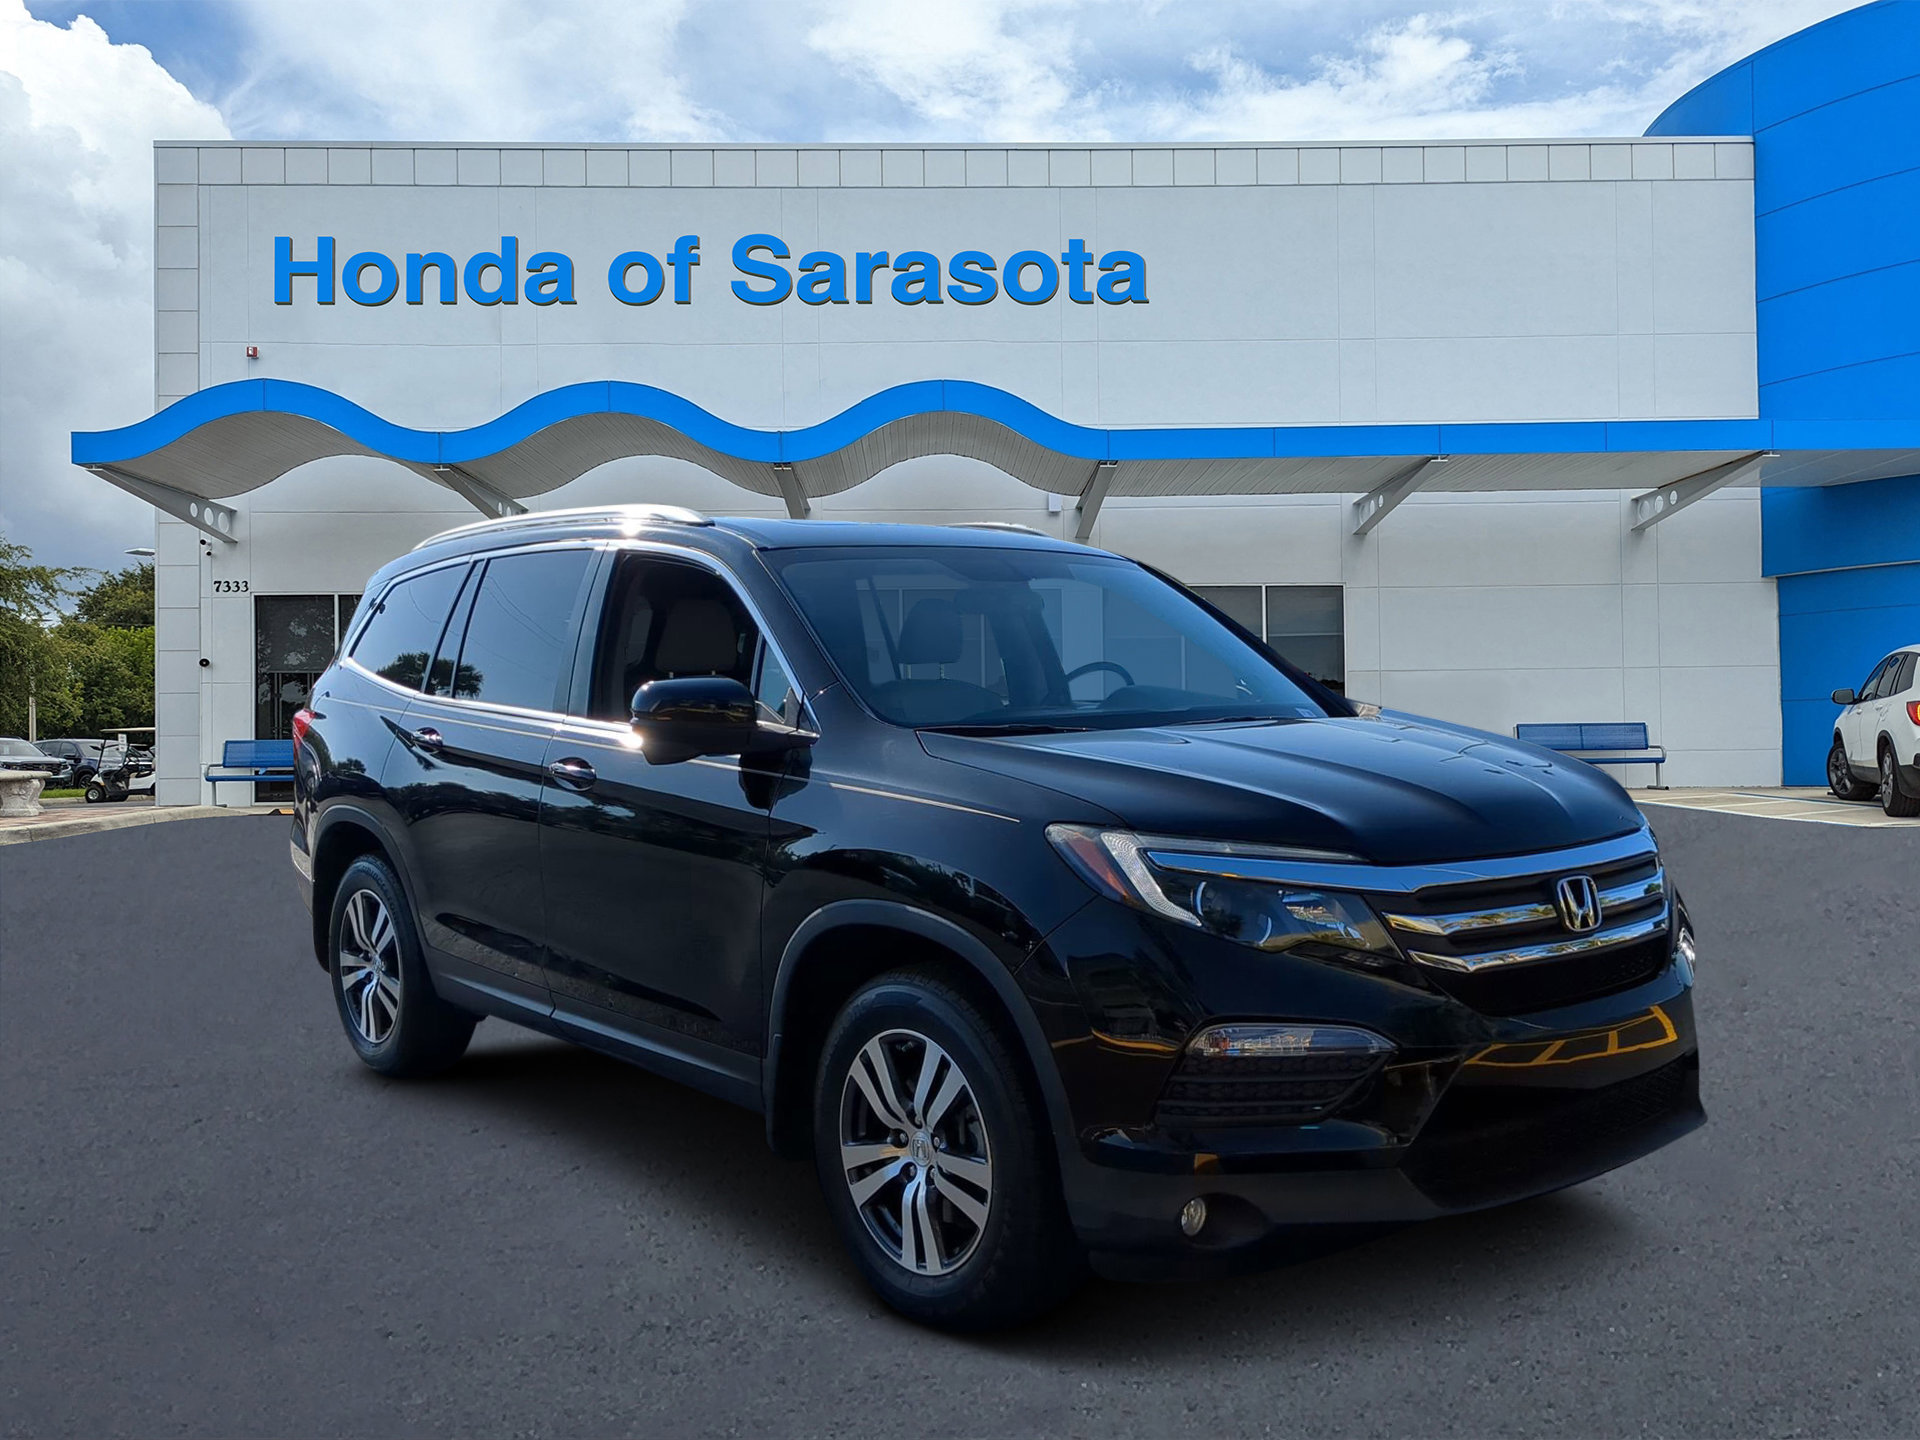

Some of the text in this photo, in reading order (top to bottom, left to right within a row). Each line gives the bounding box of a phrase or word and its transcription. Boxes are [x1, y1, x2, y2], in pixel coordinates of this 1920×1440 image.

[274, 234, 1150, 305] Honda of Sarasota
[213, 580, 249, 593] 7333
